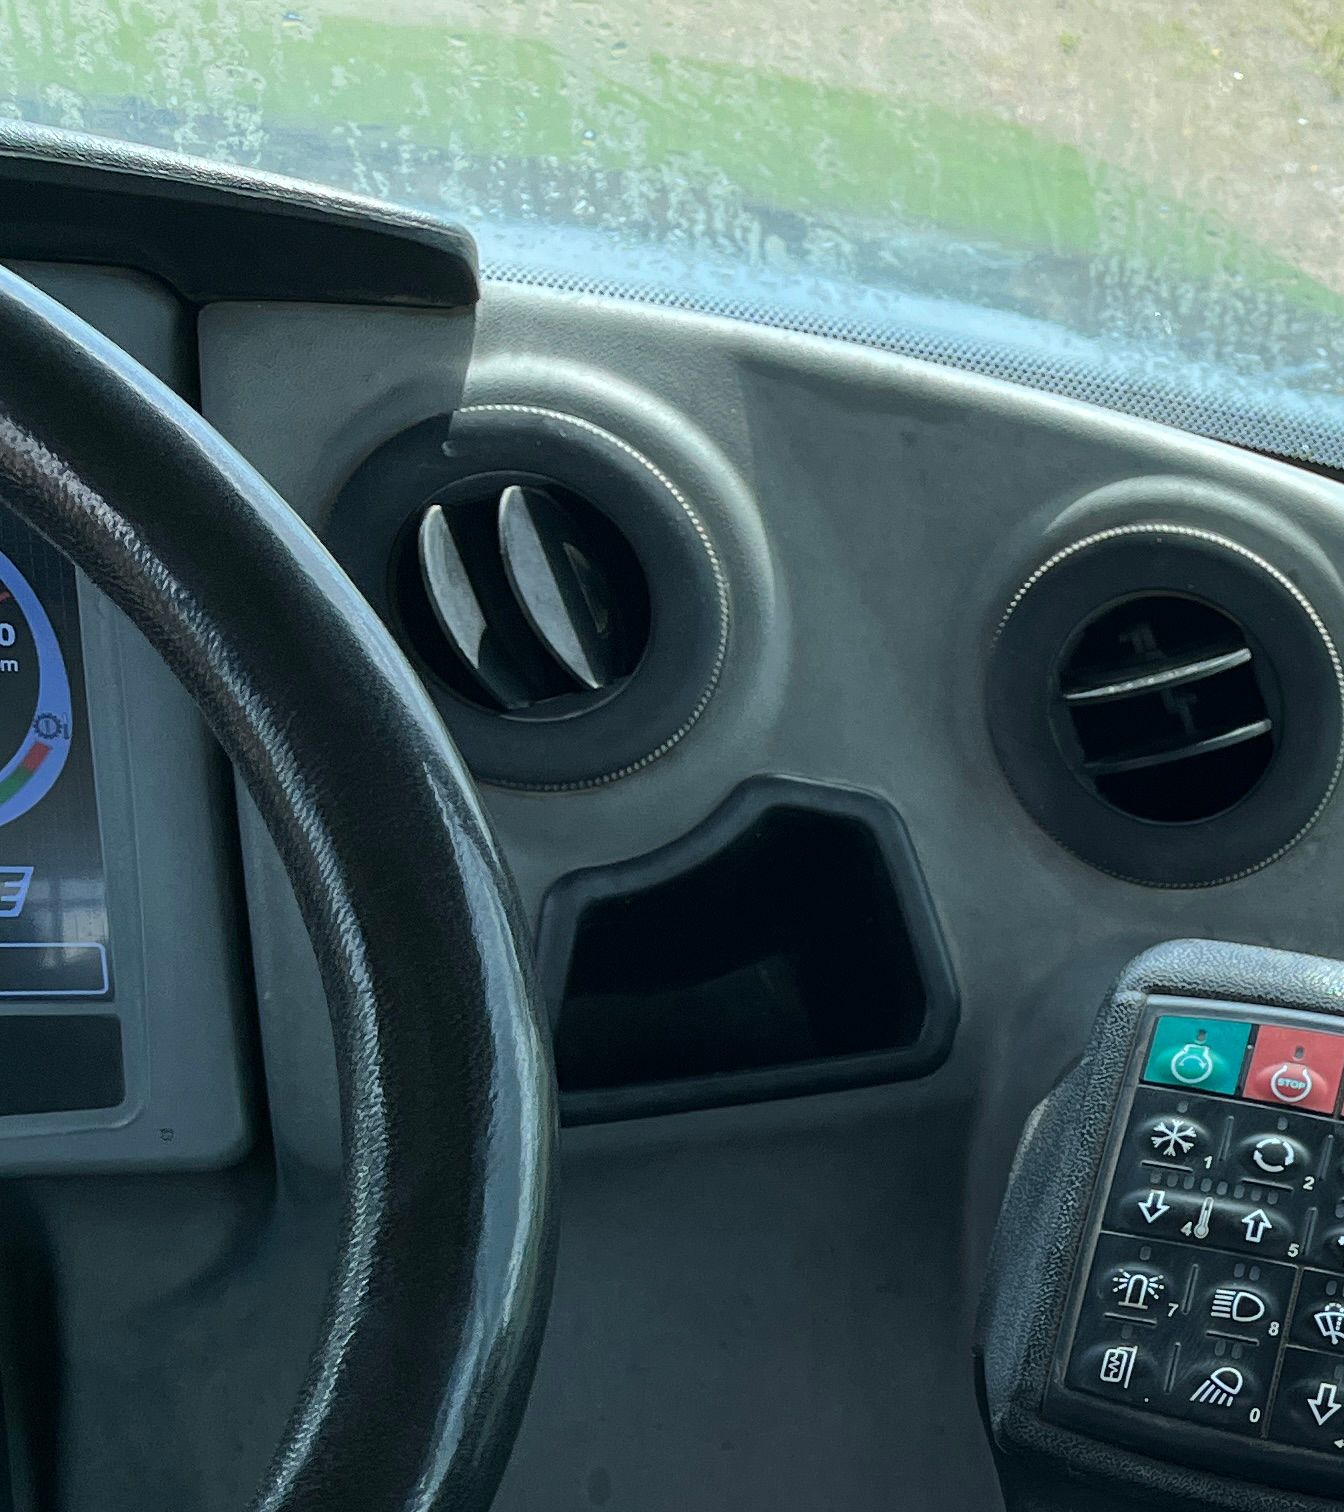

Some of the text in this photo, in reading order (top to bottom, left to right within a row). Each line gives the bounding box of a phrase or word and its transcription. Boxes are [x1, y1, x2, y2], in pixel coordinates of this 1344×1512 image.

[1302, 1175, 1316, 1191] 2
[1287, 1243, 1300, 1259] 5
[1167, 1302, 1180, 1319] 7
[1267, 1320, 1281, 1337] 8
